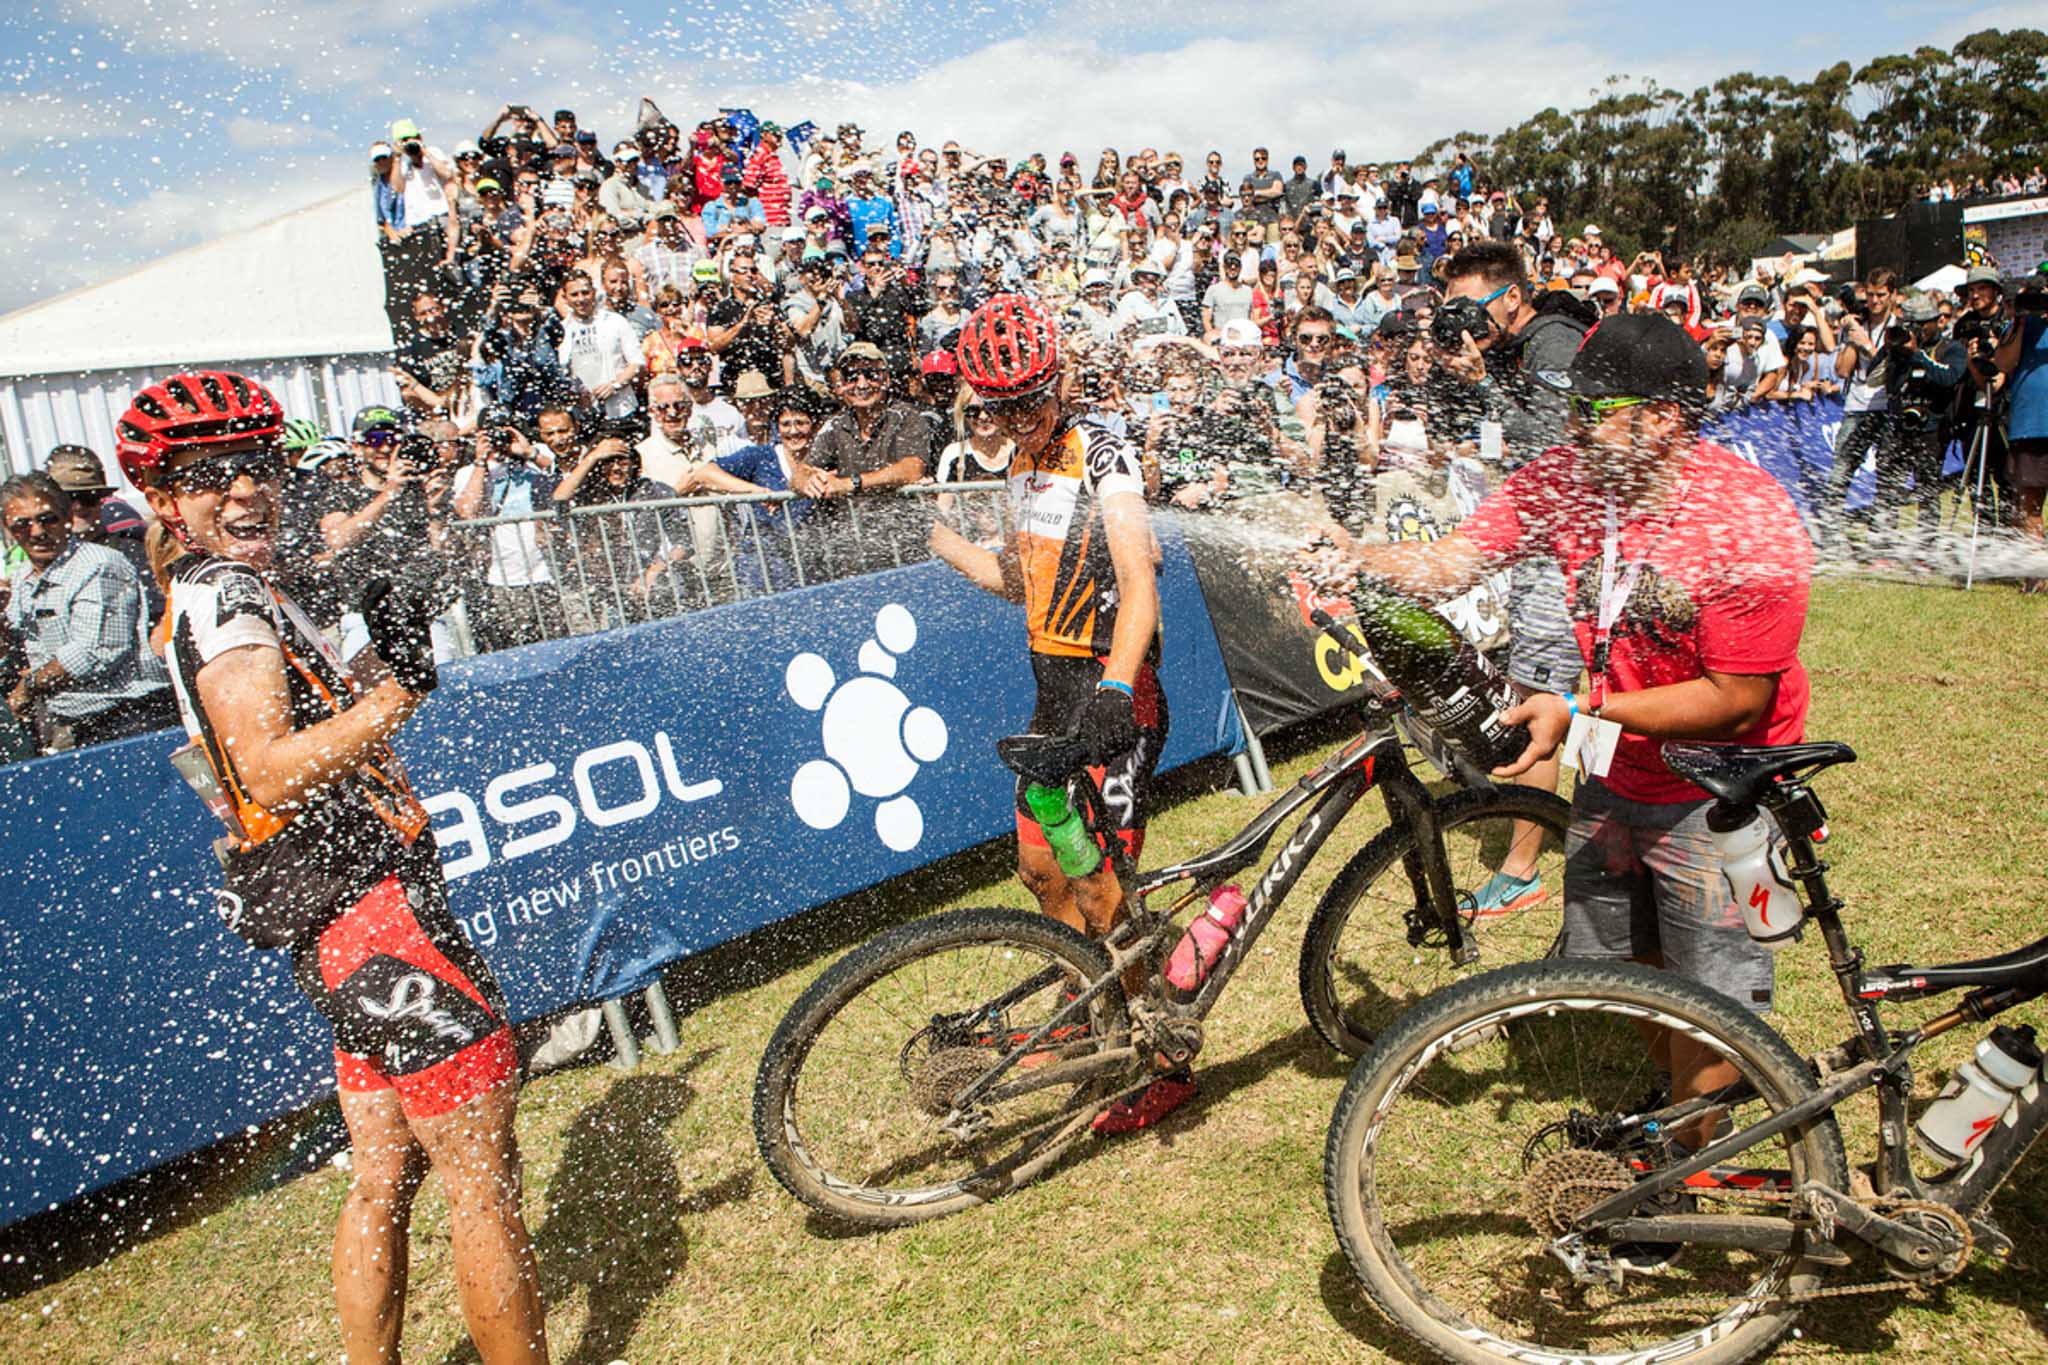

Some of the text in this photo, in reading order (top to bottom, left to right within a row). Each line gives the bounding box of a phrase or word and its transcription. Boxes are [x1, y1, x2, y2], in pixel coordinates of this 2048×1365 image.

[1315, 624, 1369, 692] CA
[420, 731, 723, 882] ASOL
[456, 826, 741, 945] ng new frontiers
